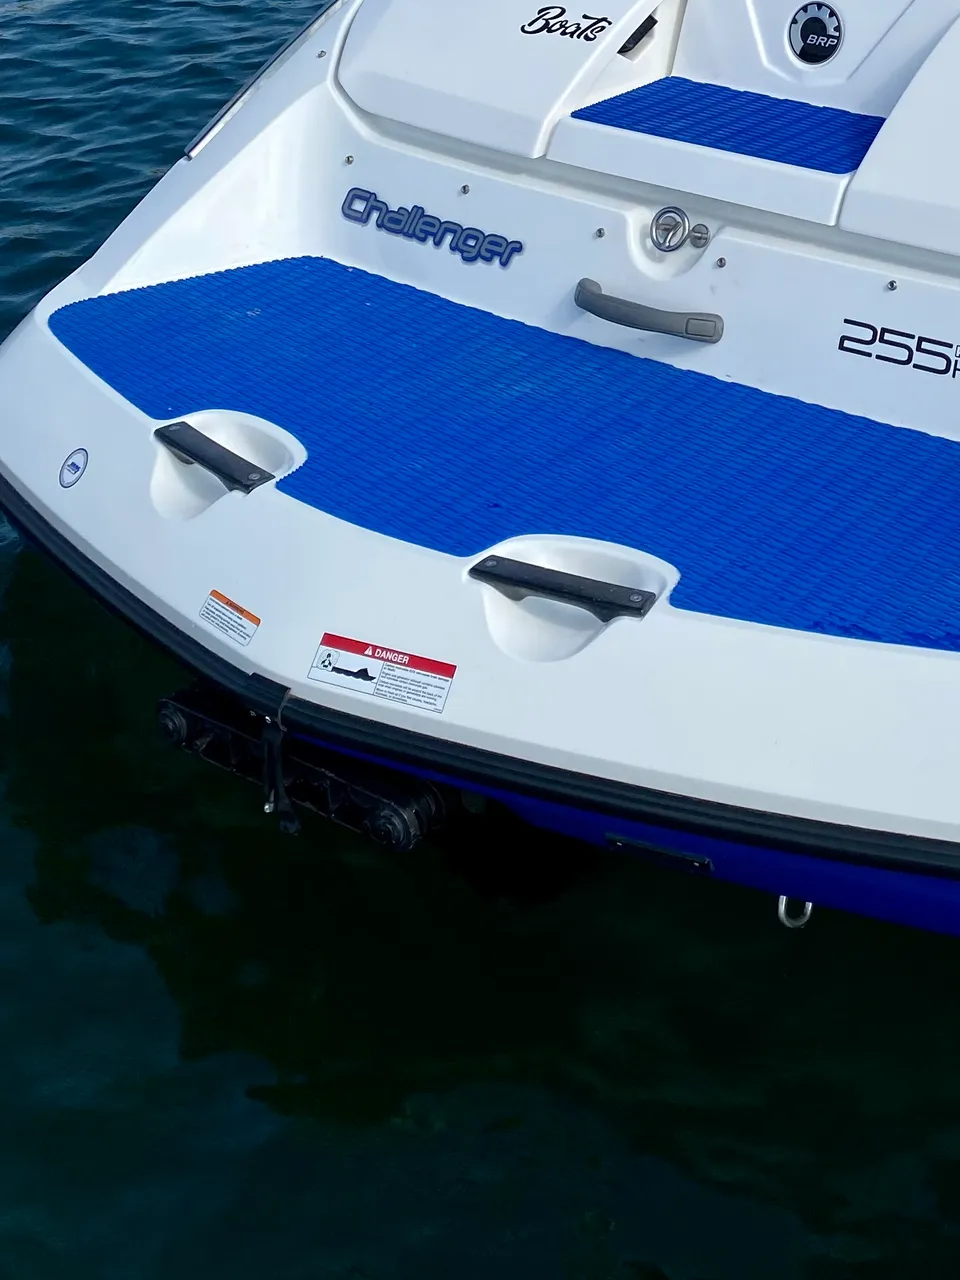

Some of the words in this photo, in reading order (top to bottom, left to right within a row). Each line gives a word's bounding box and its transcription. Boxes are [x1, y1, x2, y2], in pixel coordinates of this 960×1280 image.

[520, 5, 612, 42] Boats
[806, 33, 838, 48] BRP
[341, 187, 523, 266] Challenger
[838, 318, 953, 375] 255
[374, 648, 410, 665] DANGER
